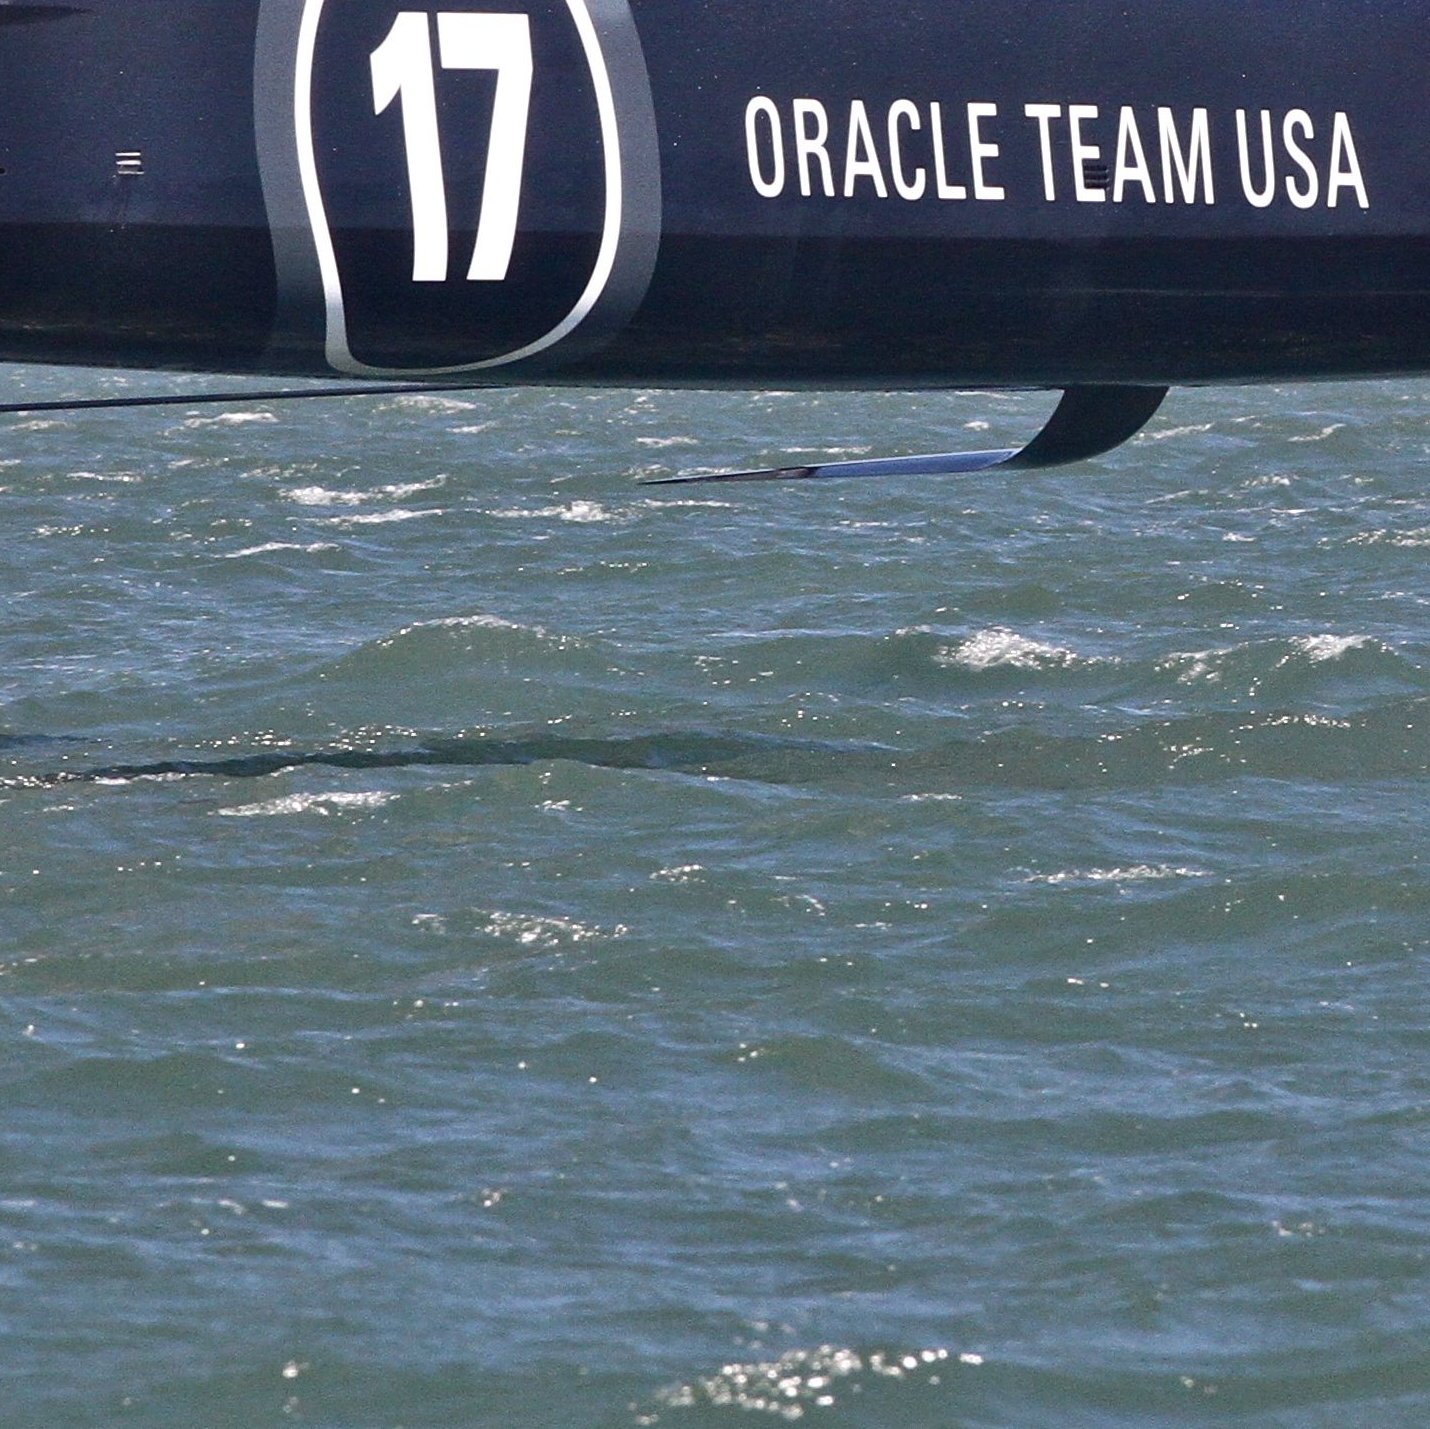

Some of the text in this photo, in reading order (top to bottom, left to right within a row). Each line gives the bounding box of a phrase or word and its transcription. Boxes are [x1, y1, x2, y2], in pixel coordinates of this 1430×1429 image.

[369, 10, 533, 282] 17
[744, 95, 1371, 210] ORACLE TEAM USA
